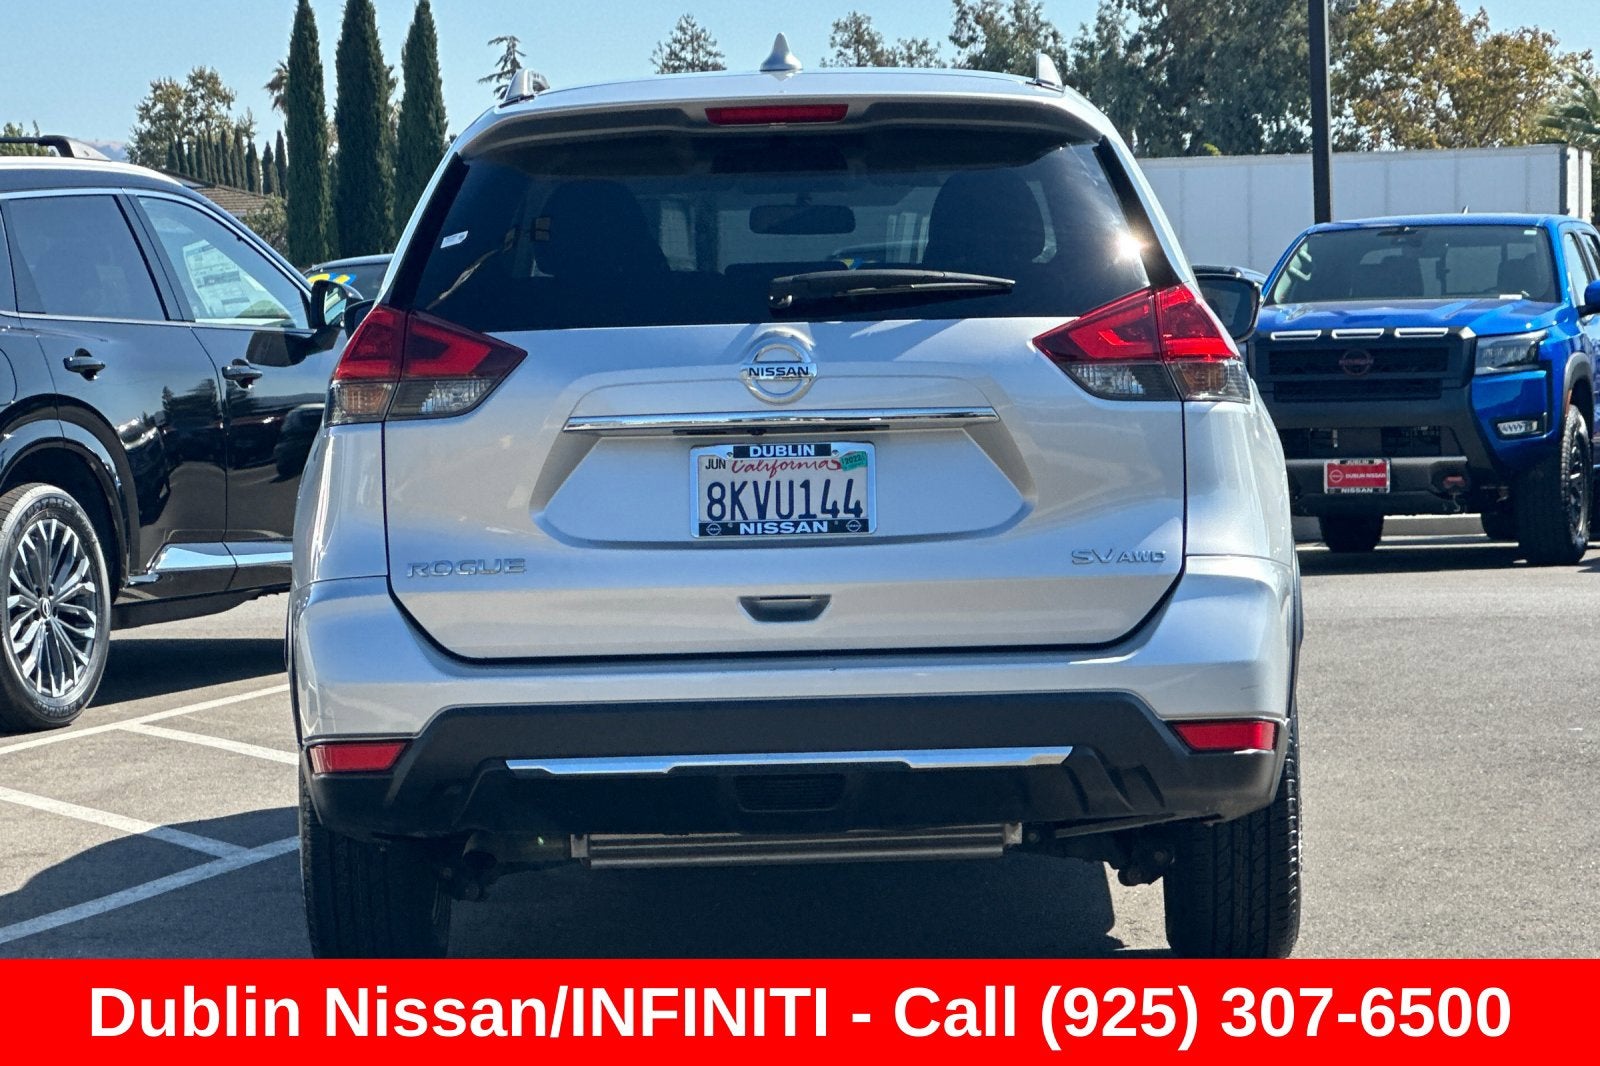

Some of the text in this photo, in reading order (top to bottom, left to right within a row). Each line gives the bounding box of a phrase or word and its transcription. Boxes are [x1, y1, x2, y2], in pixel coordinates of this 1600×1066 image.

[748, 366, 809, 377] NISSAN
[749, 444, 815, 458] DUBLIN
[705, 459, 726, 470] JUN
[706, 478, 864, 522] 8KVU144
[739, 521, 828, 535] NISSAN
[1071, 548, 1166, 565] SV AWD
[406, 558, 527, 578] ROGUE
